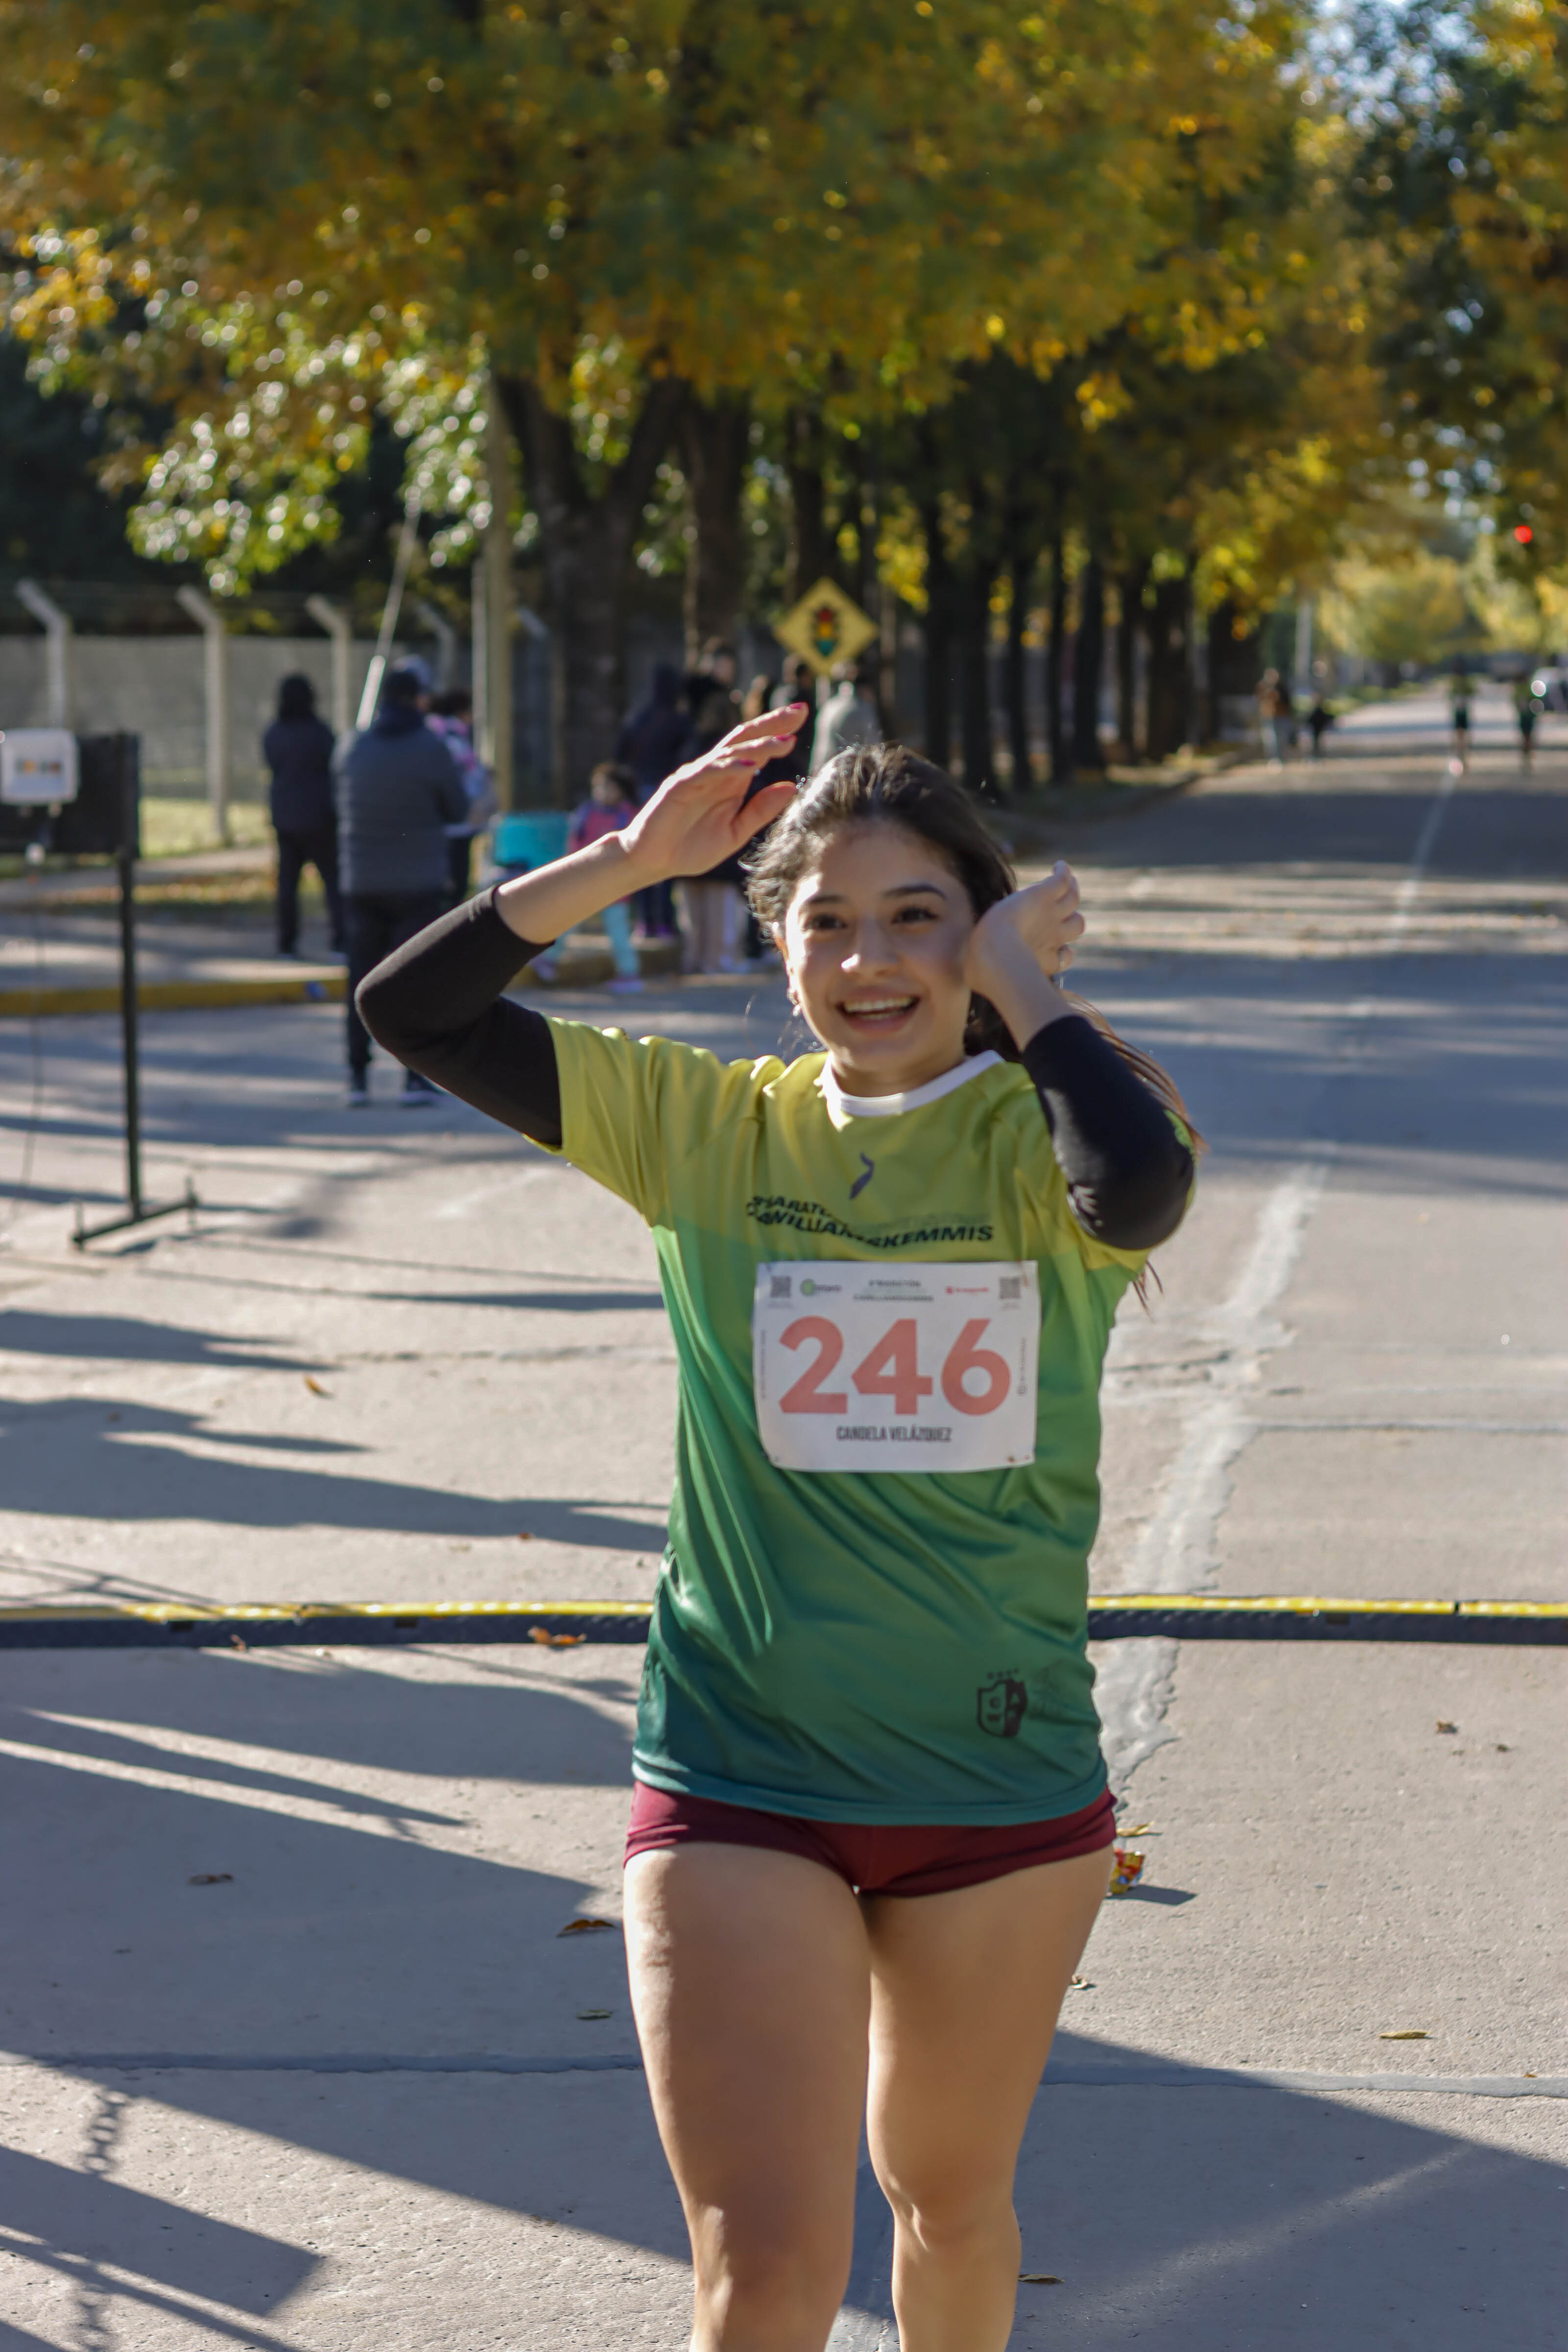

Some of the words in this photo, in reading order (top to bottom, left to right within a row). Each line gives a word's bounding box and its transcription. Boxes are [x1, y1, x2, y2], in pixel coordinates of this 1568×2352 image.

[882, 1225, 994, 1248] KEMMIS
[779, 1316, 1010, 1415] 246
[836, 1426, 887, 1442] CANDELA
[888, 1423, 952, 1443] VELÁZQUEZ
